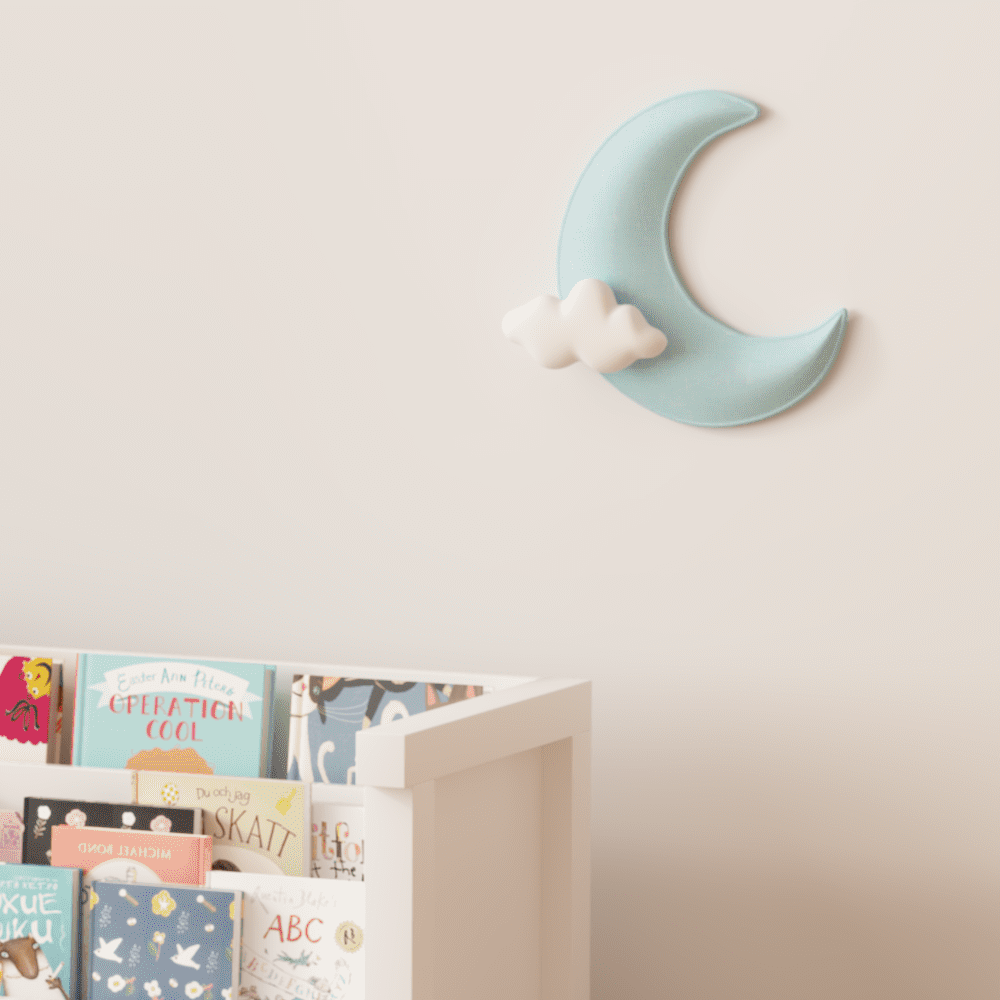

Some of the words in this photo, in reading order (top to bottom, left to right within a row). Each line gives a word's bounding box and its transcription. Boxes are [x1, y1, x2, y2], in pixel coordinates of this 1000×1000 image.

[109, 693, 243, 722] OPERATION
[146, 719, 203, 742] COOL
[196, 786, 211, 800] Du
[213, 785, 232, 799] och
[232, 789, 251, 805] jag
[213, 805, 297, 857] SKATT
[330, 860, 356, 879] the
[263, 915, 324, 943] ABC
